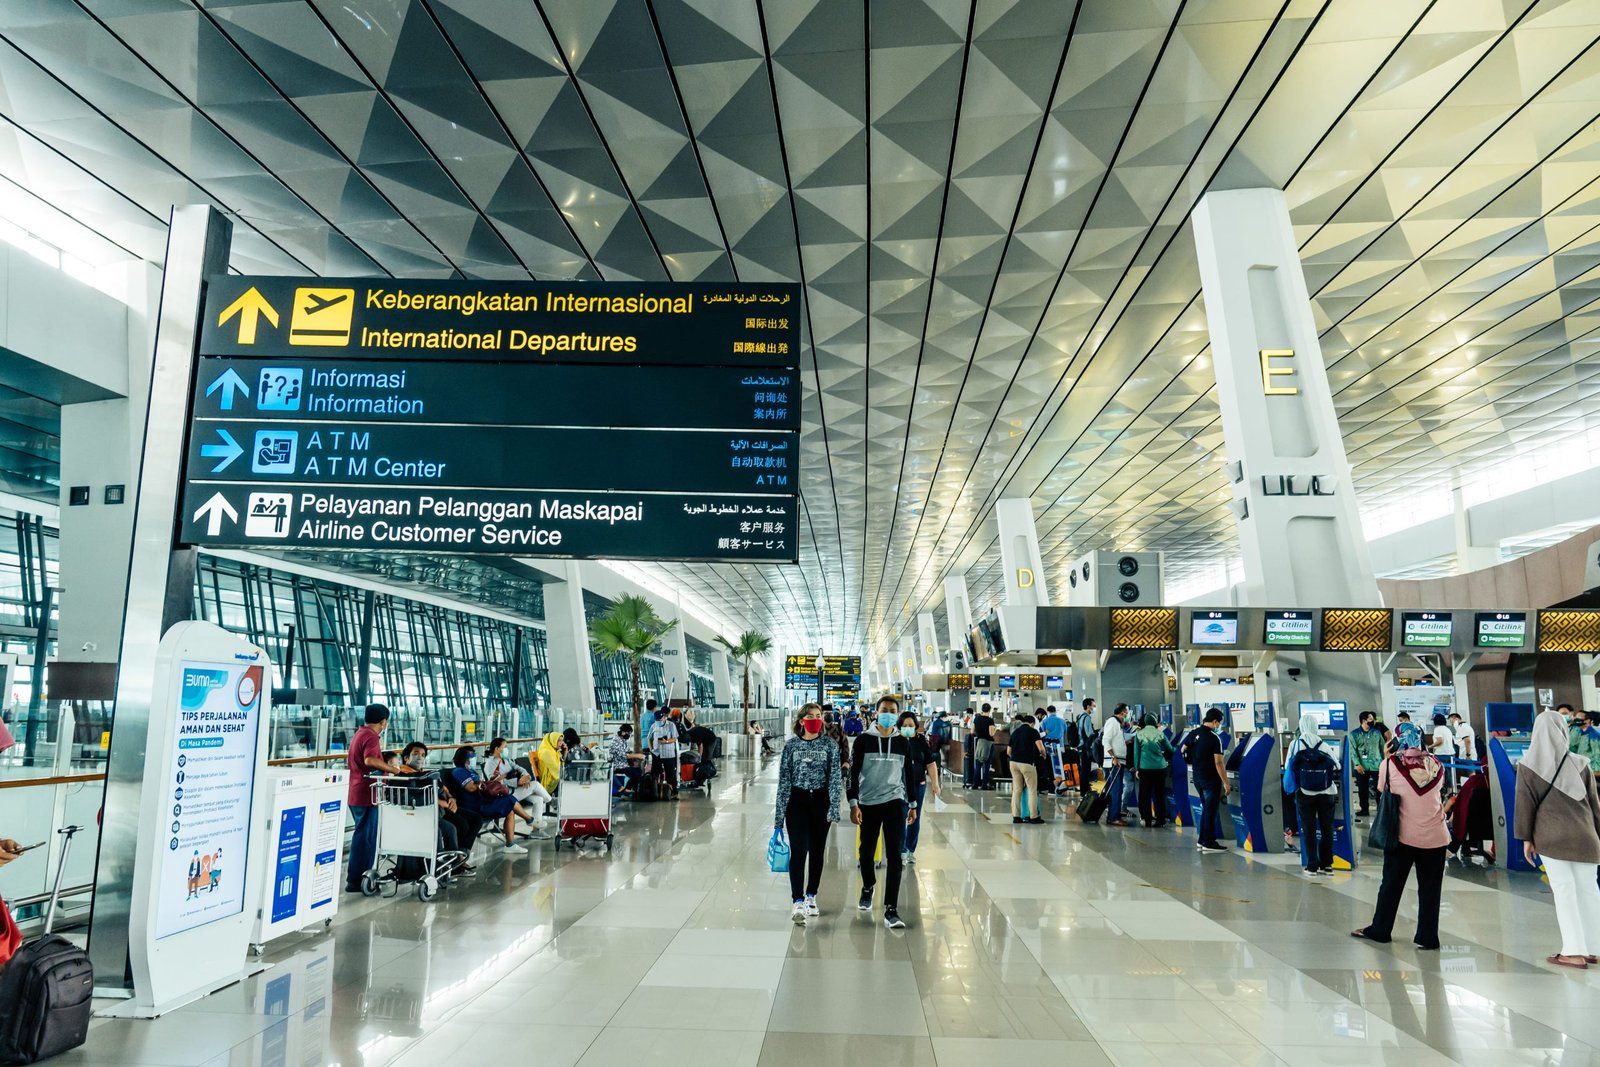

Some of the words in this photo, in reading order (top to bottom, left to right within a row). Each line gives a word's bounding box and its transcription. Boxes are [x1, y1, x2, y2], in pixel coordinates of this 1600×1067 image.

[365, 289, 538, 316] Keberangkatan
[547, 292, 692, 313] Internasional
[733, 293, 757, 305] الدولية
[759, 294, 790, 305] الرحلات
[745, 317, 789, 330] 国际出发
[362, 327, 501, 349] International
[510, 330, 636, 354] Departures
[733, 341, 788, 354] 国際線出発
[1259, 349, 1298, 395] E
[311, 369, 405, 388] Informasi
[741, 376, 789, 386] الاستعلامات
[754, 391, 788, 403] 问询处
[308, 394, 423, 413] Information
[754, 407, 787, 419] 案内所
[375, 458, 445, 477] Center
[731, 455, 787, 468] 自动取款机
[300, 493, 410, 519] Pelayanan
[418, 496, 532, 523] Pelanggan
[540, 499, 643, 525] Maskapai
[683, 503, 708, 515] الجوية
[765, 505, 786, 514] خدمة
[298, 520, 364, 540] Airline
[371, 521, 475, 543] Customer
[481, 523, 562, 546] Service
[739, 520, 785, 534] 客户服务
[1016, 568, 1035, 588] D
[1420, 622, 1449, 630] Citilink
[926, 645, 934, 655] C
[907, 658, 913, 667] B
[182, 712, 199, 721] TIPS
[200, 712, 248, 721] PERJALANAN
[180, 724, 204, 734] AMAN
[205, 724, 221, 733] DAN
[222, 723, 246, 733] SEHAT
[187, 739, 201, 747] Masa
[201, 738, 223, 746] Pandemi
